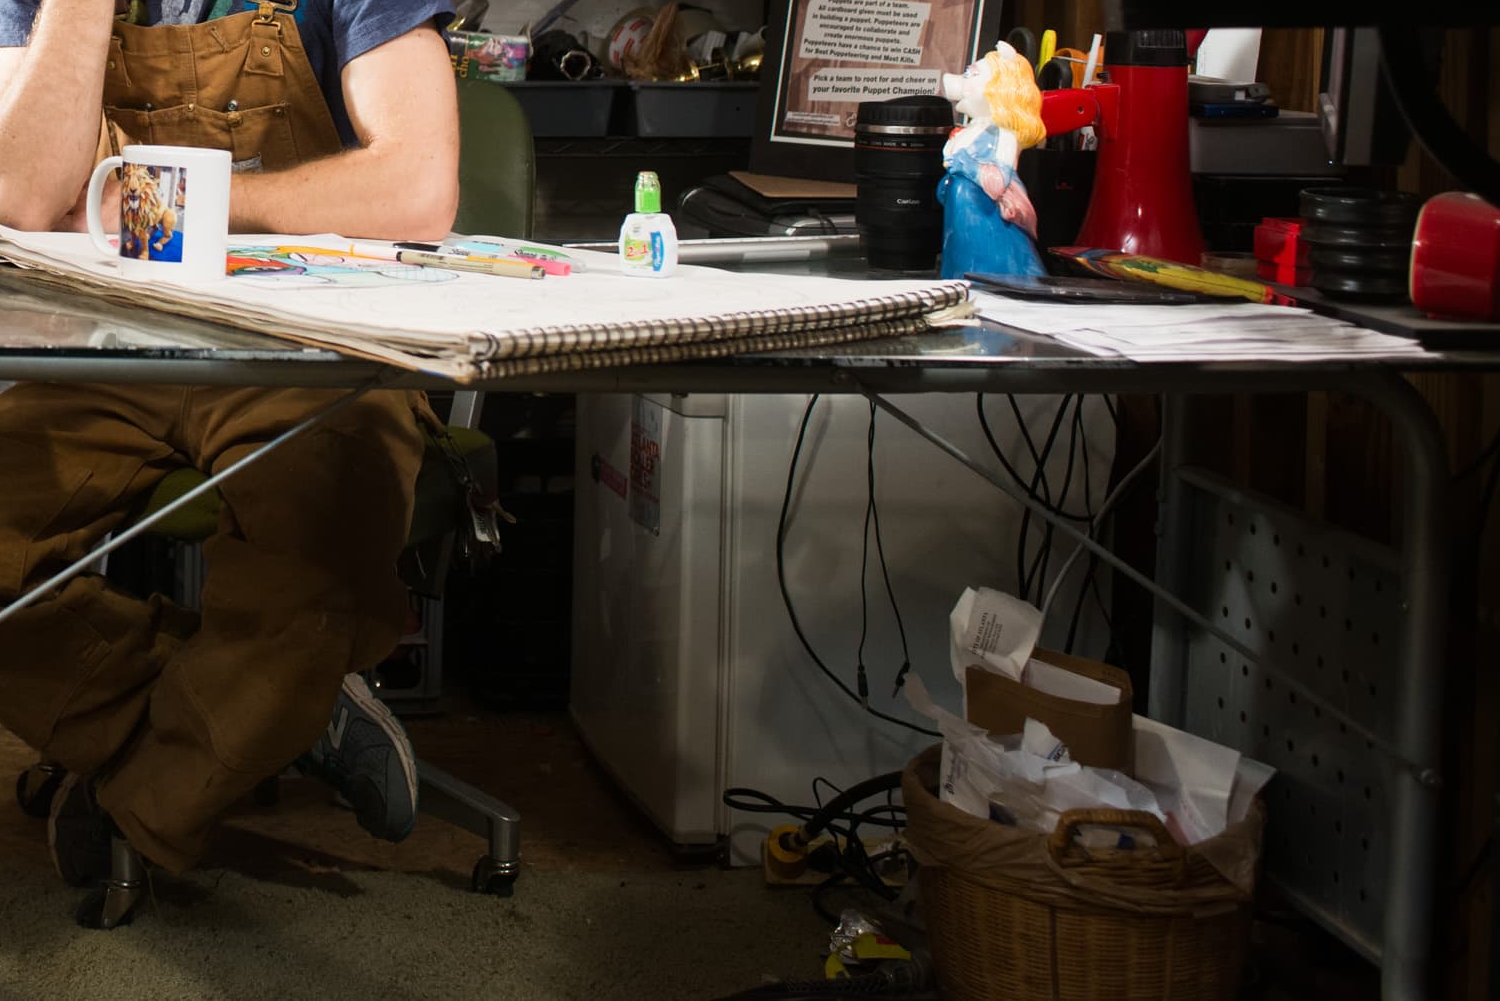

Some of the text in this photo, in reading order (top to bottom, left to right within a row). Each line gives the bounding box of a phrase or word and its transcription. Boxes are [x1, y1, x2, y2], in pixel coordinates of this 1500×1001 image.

[832, 85, 860, 93] favorite
[862, 86, 890, 95] Puppet
[892, 86, 935, 95] Champion!
